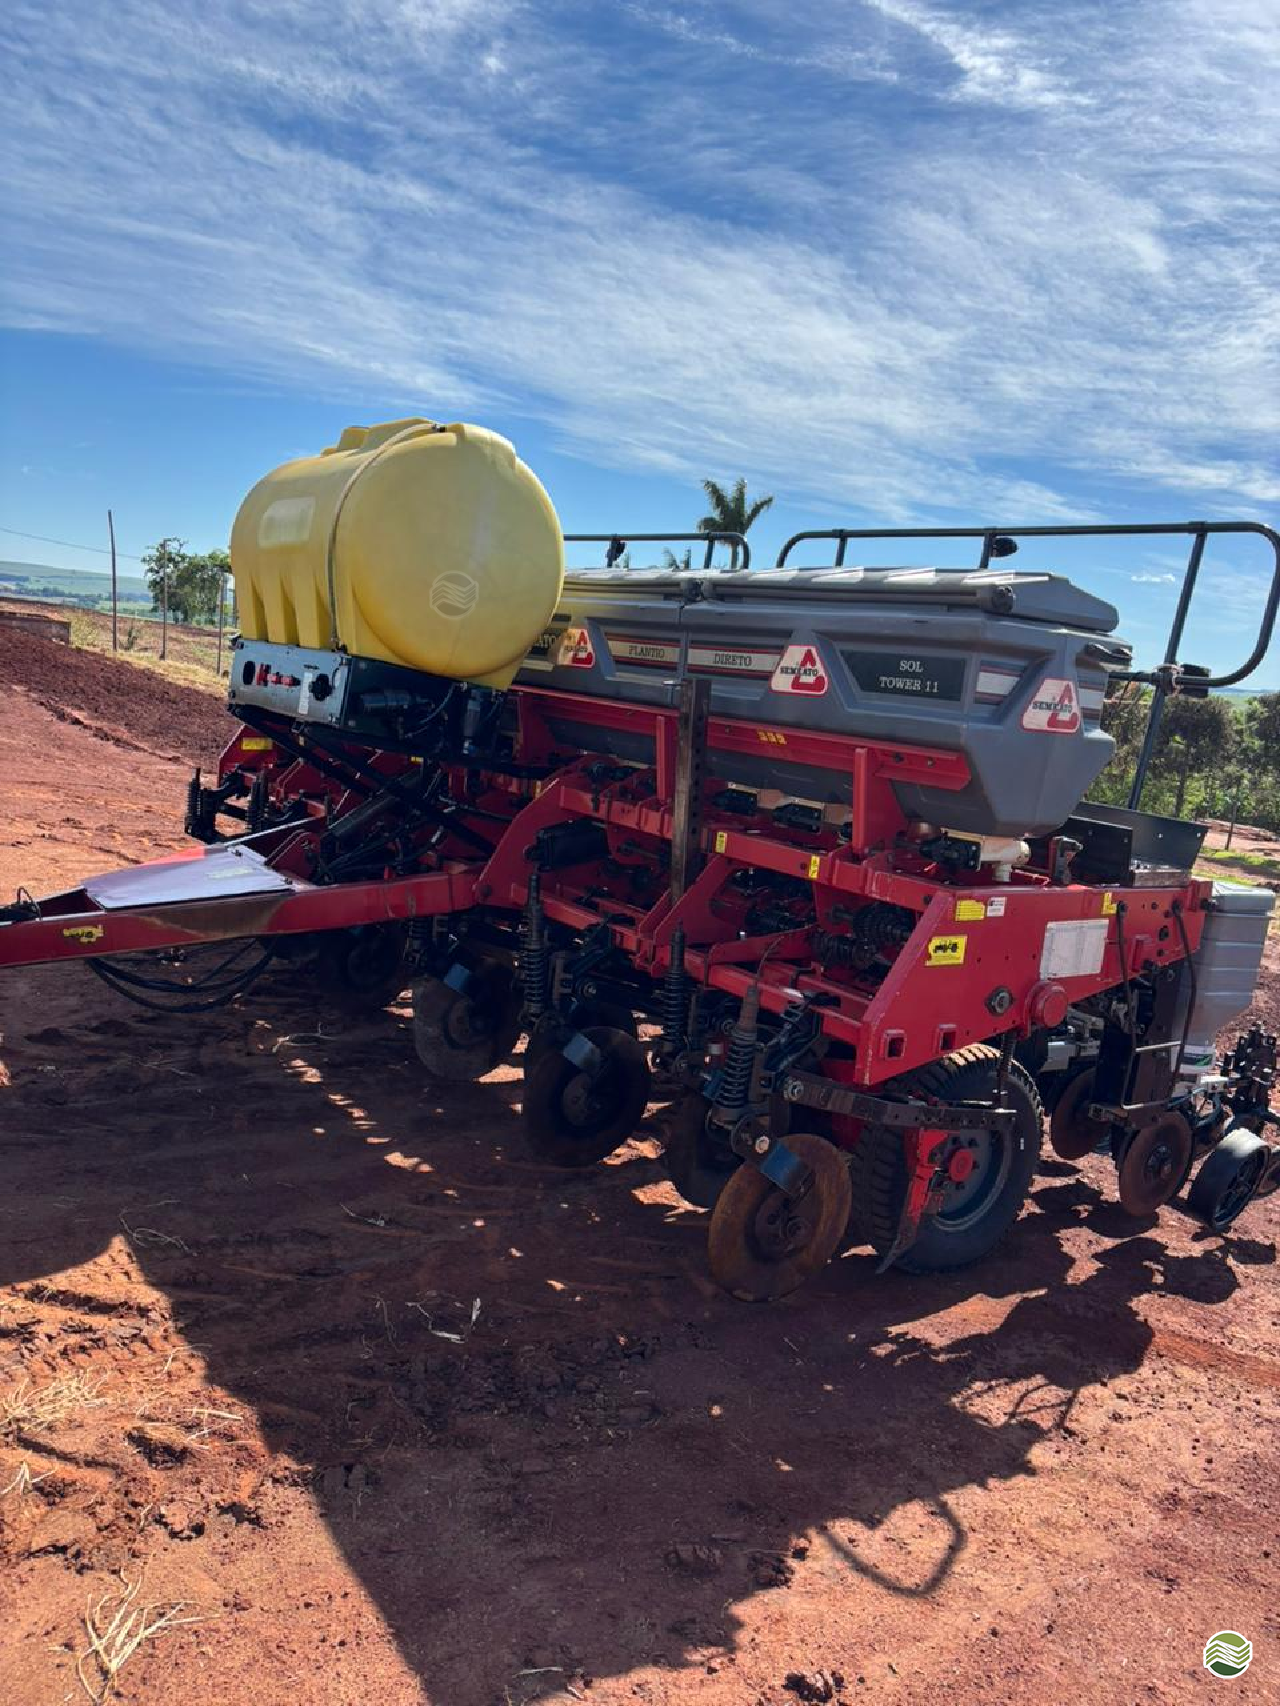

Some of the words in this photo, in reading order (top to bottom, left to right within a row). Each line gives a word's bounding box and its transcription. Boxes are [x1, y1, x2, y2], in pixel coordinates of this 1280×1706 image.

[713, 653, 753, 667] DIRETO
[899, 660, 924, 673] SOL
[879, 676, 921, 691] TOWER
[924, 680, 940, 693] 11
